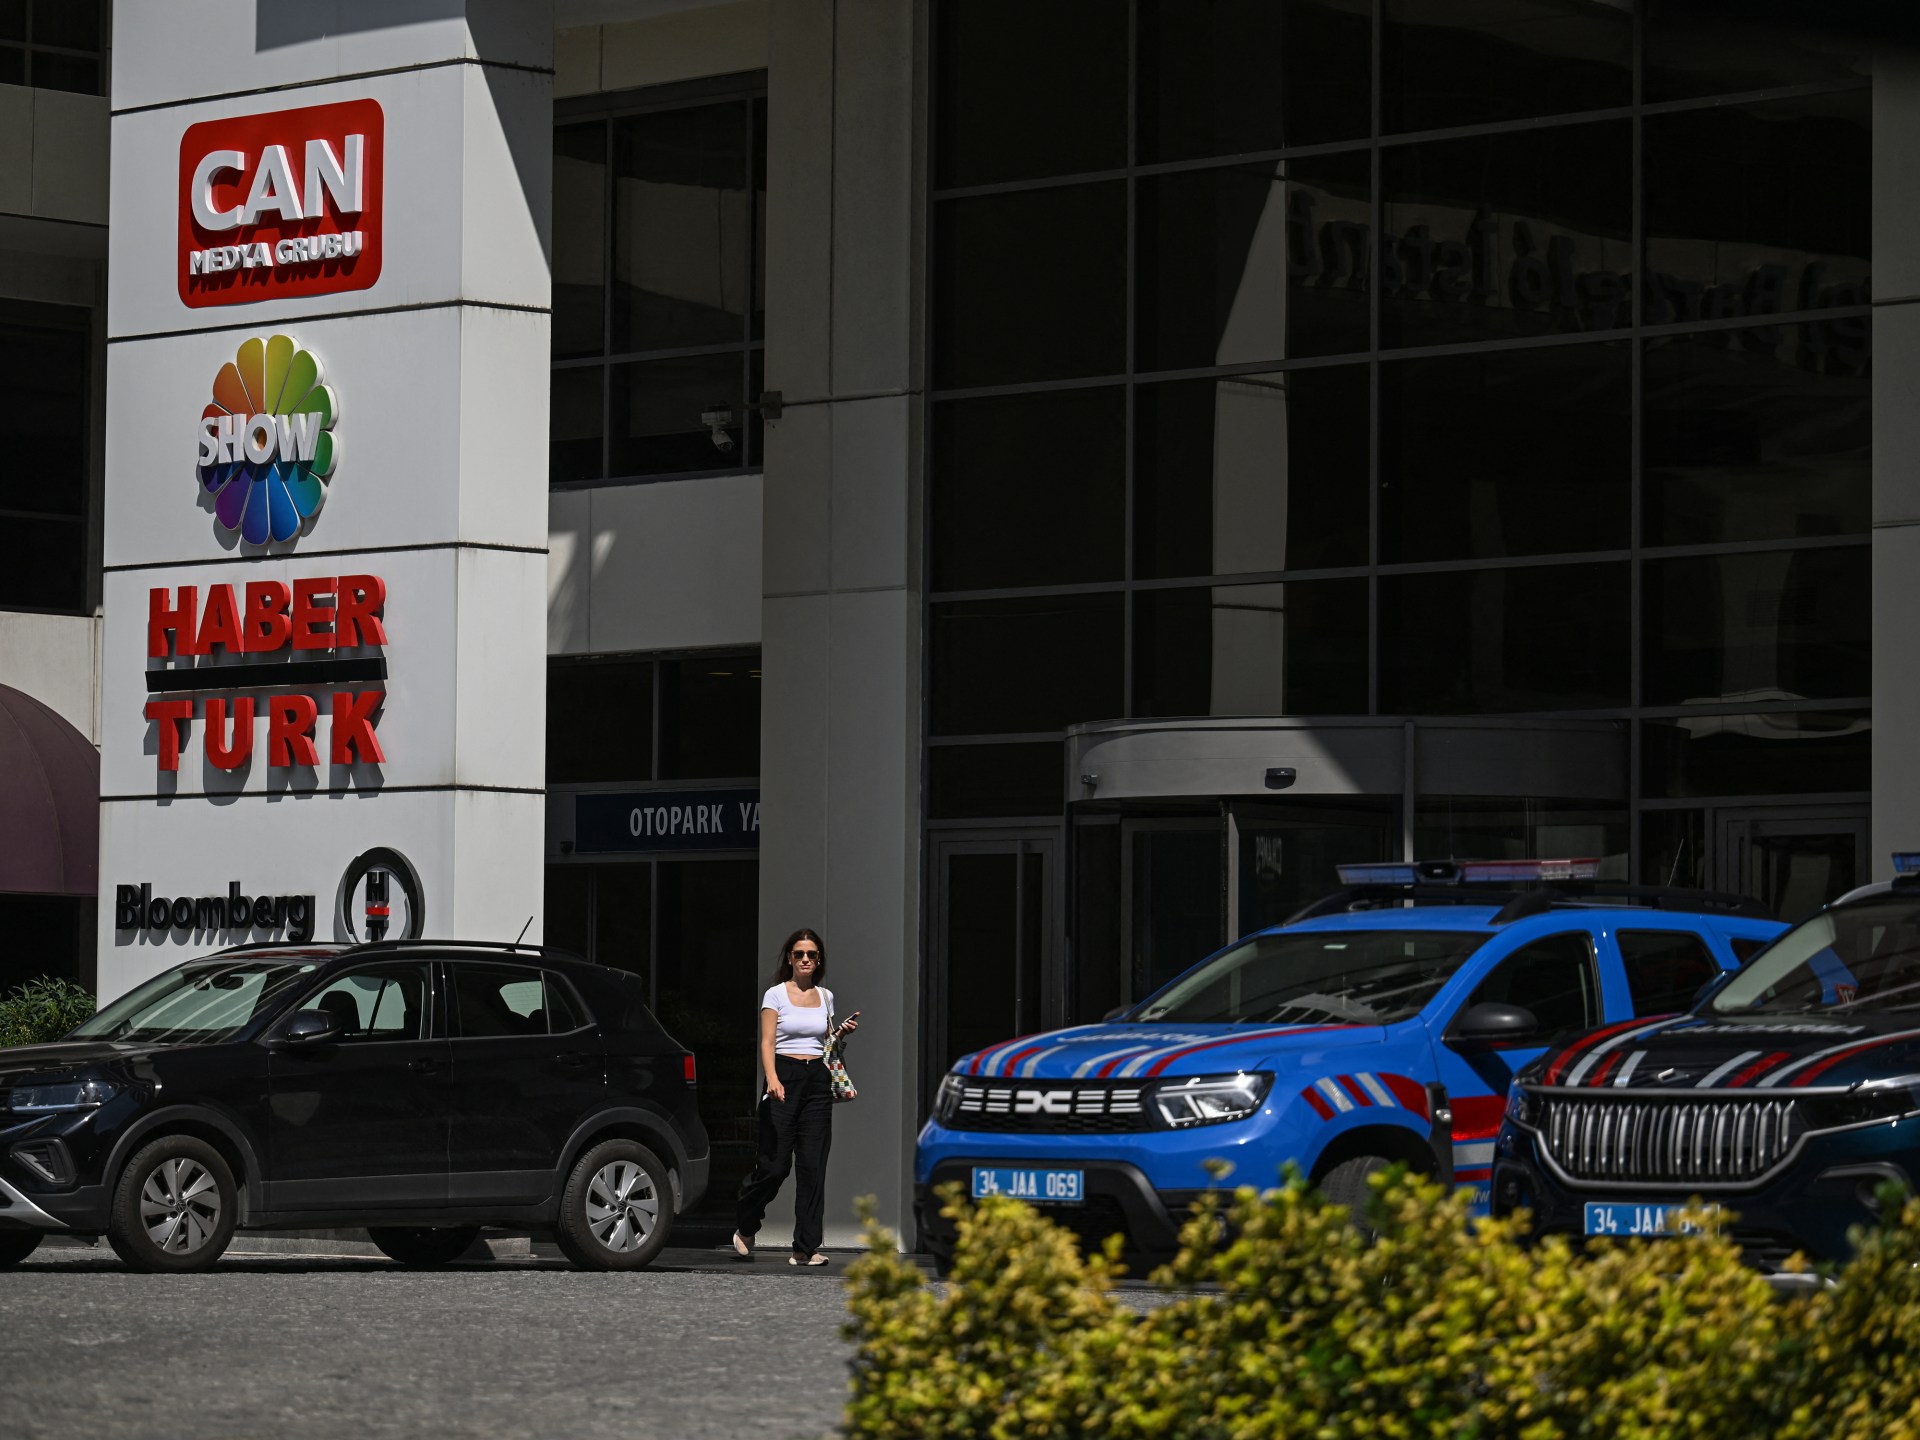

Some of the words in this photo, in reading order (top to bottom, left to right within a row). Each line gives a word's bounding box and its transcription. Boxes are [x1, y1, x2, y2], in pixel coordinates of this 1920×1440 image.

[191, 134, 364, 231] CAN
[190, 242, 273, 275] MEDYA
[276, 231, 363, 265] GRUBU
[199, 412, 323, 466] SHOW
[148, 574, 388, 657] HABER
[145, 691, 387, 771] TURK
[629, 804, 724, 837] OTOPARK
[739, 802, 760, 832] YA
[115, 881, 316, 942] Bloomberg
[979, 1170, 999, 1195] 34
[1007, 1171, 1038, 1196] JAA
[1046, 1172, 1078, 1197] 069
[1593, 1207, 1617, 1233] 34
[1629, 1207, 1665, 1234] JAA
